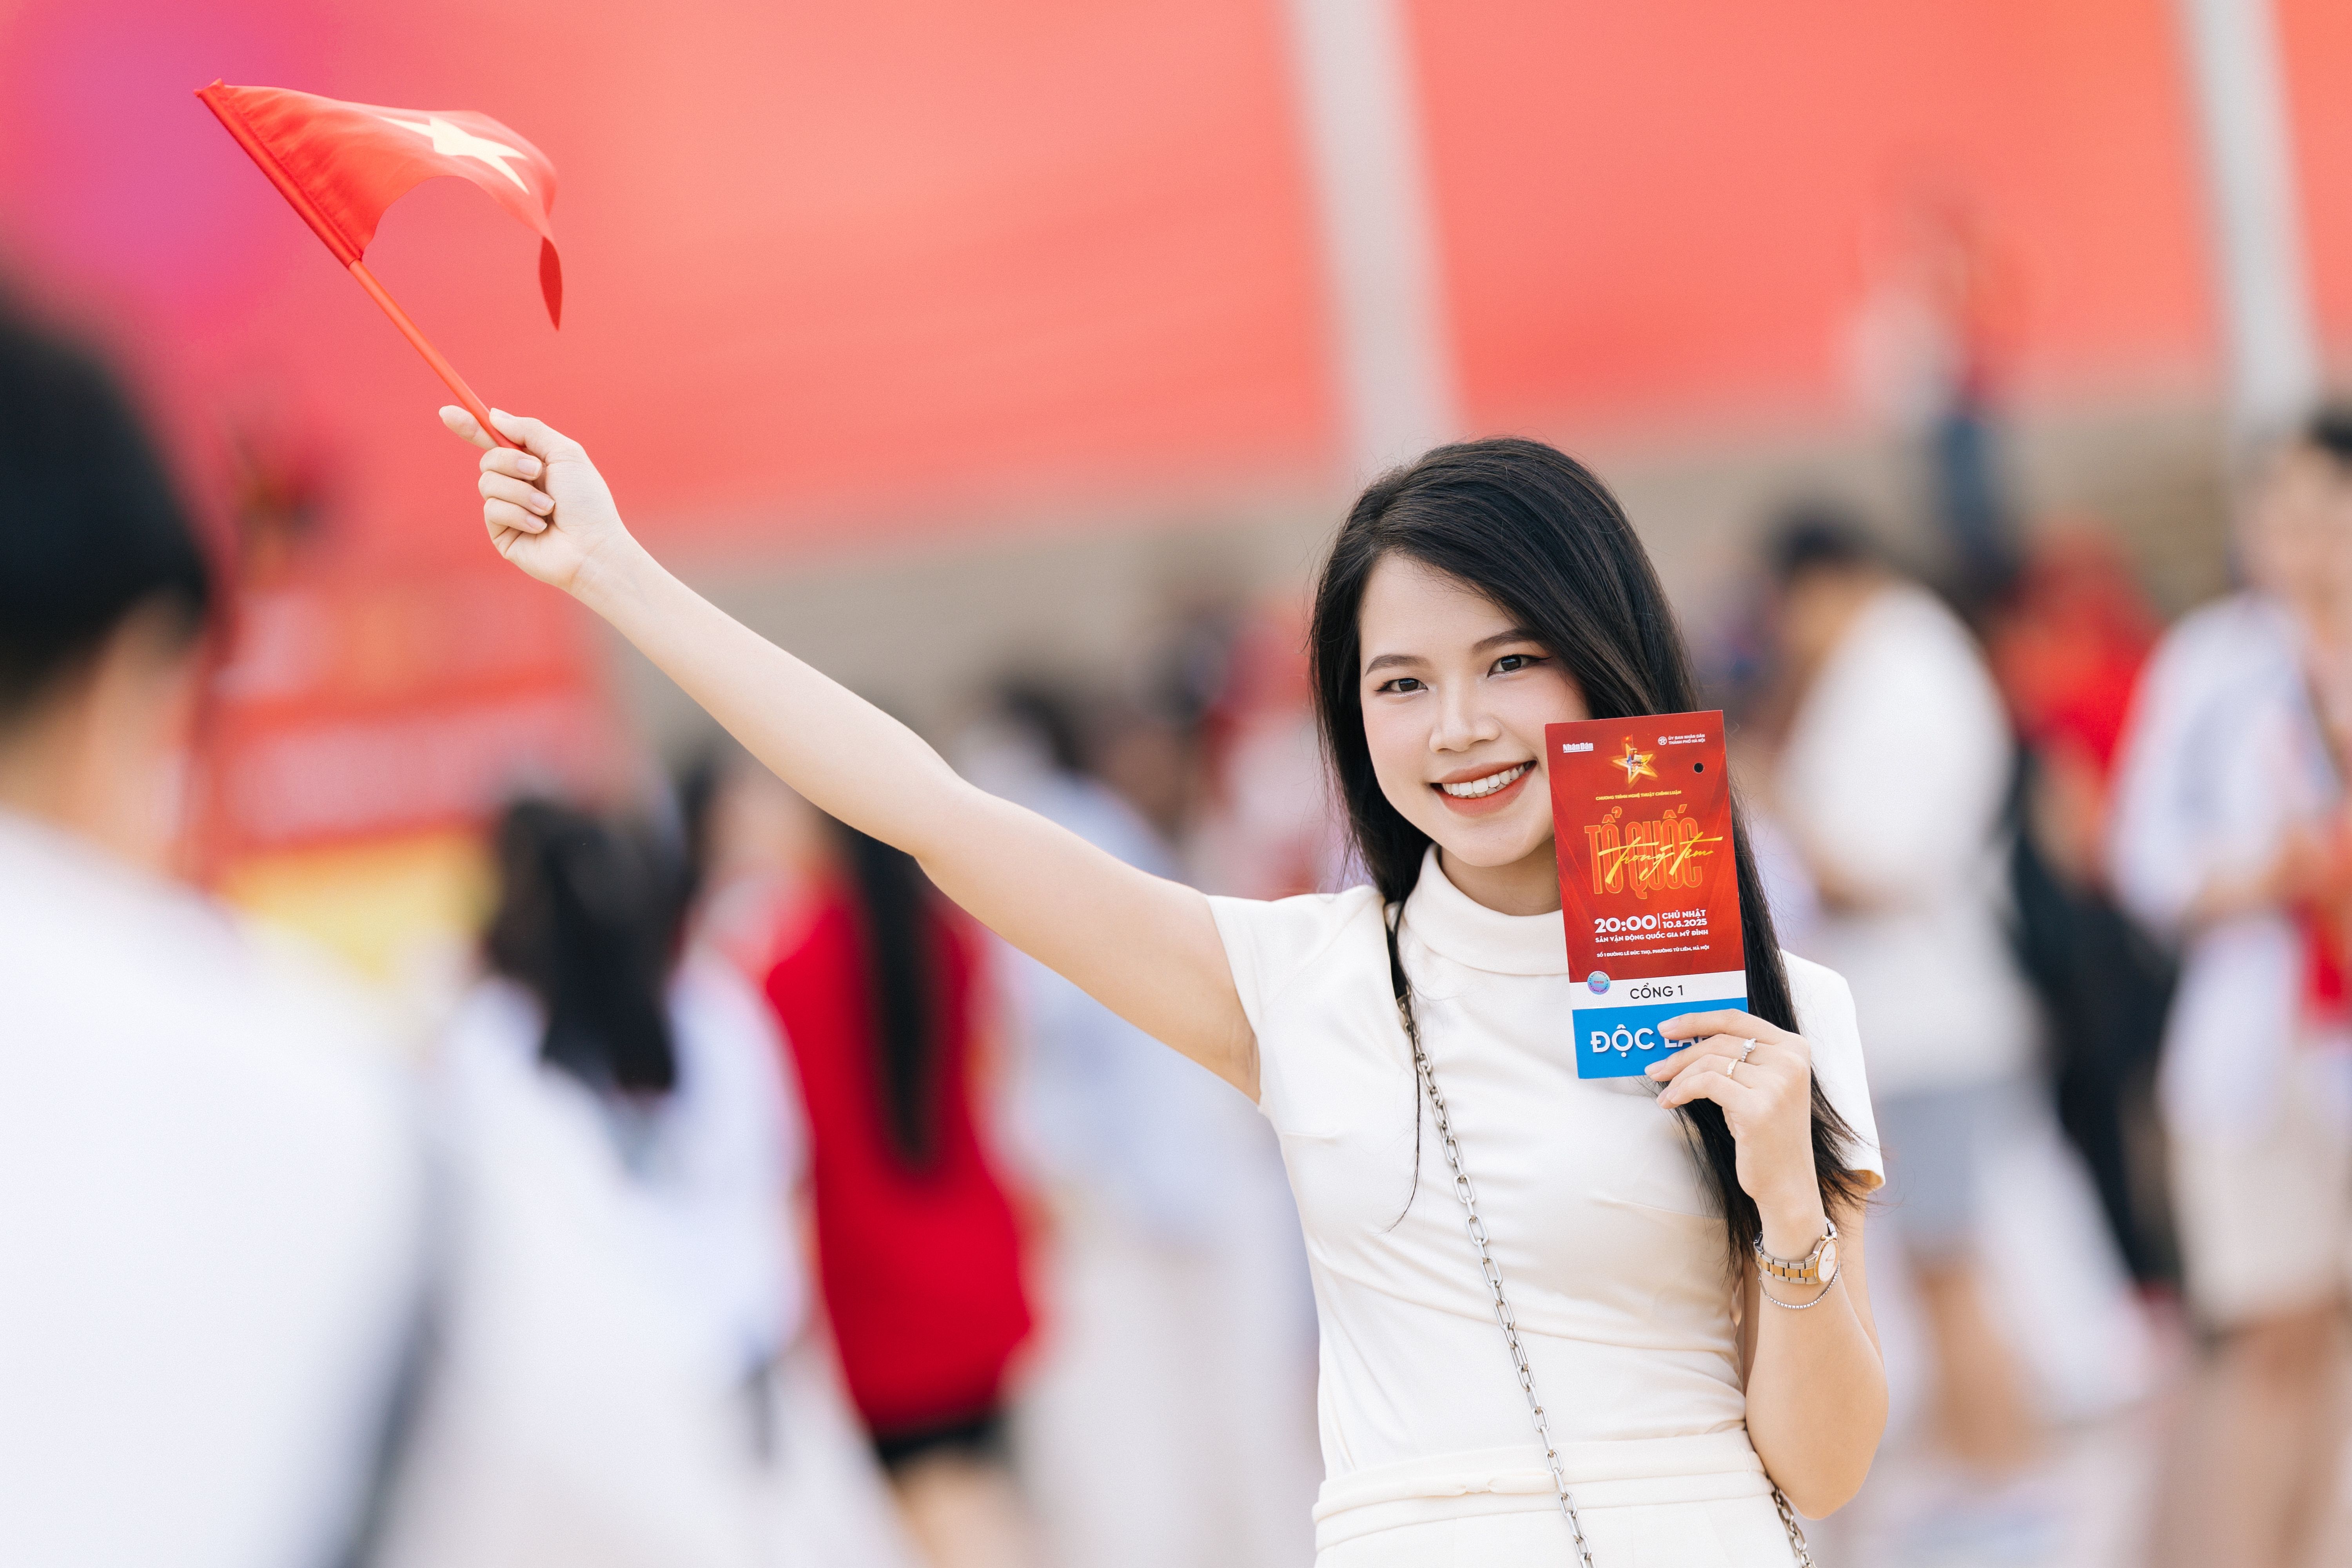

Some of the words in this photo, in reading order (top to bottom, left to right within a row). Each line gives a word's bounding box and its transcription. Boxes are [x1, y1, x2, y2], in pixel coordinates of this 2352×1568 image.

[1584, 806, 1624, 894] TỔ
[1625, 804, 1702, 899] QUỐC
[1662, 910, 1680, 919] CHỦ
[1682, 908, 1706, 918] NHẬT
[1594, 915, 1657, 933] 20:00
[1662, 918, 1707, 929] 10.8.2025
[1610, 935, 1624, 943] VẬN
[1625, 934, 1644, 942] ĐỘNG
[1646, 931, 1665, 939] QUỐC
[1630, 983, 1673, 999] CỔNG
[1678, 985, 1683, 996] 1
[1590, 1024, 1655, 1057] ĐỘC
